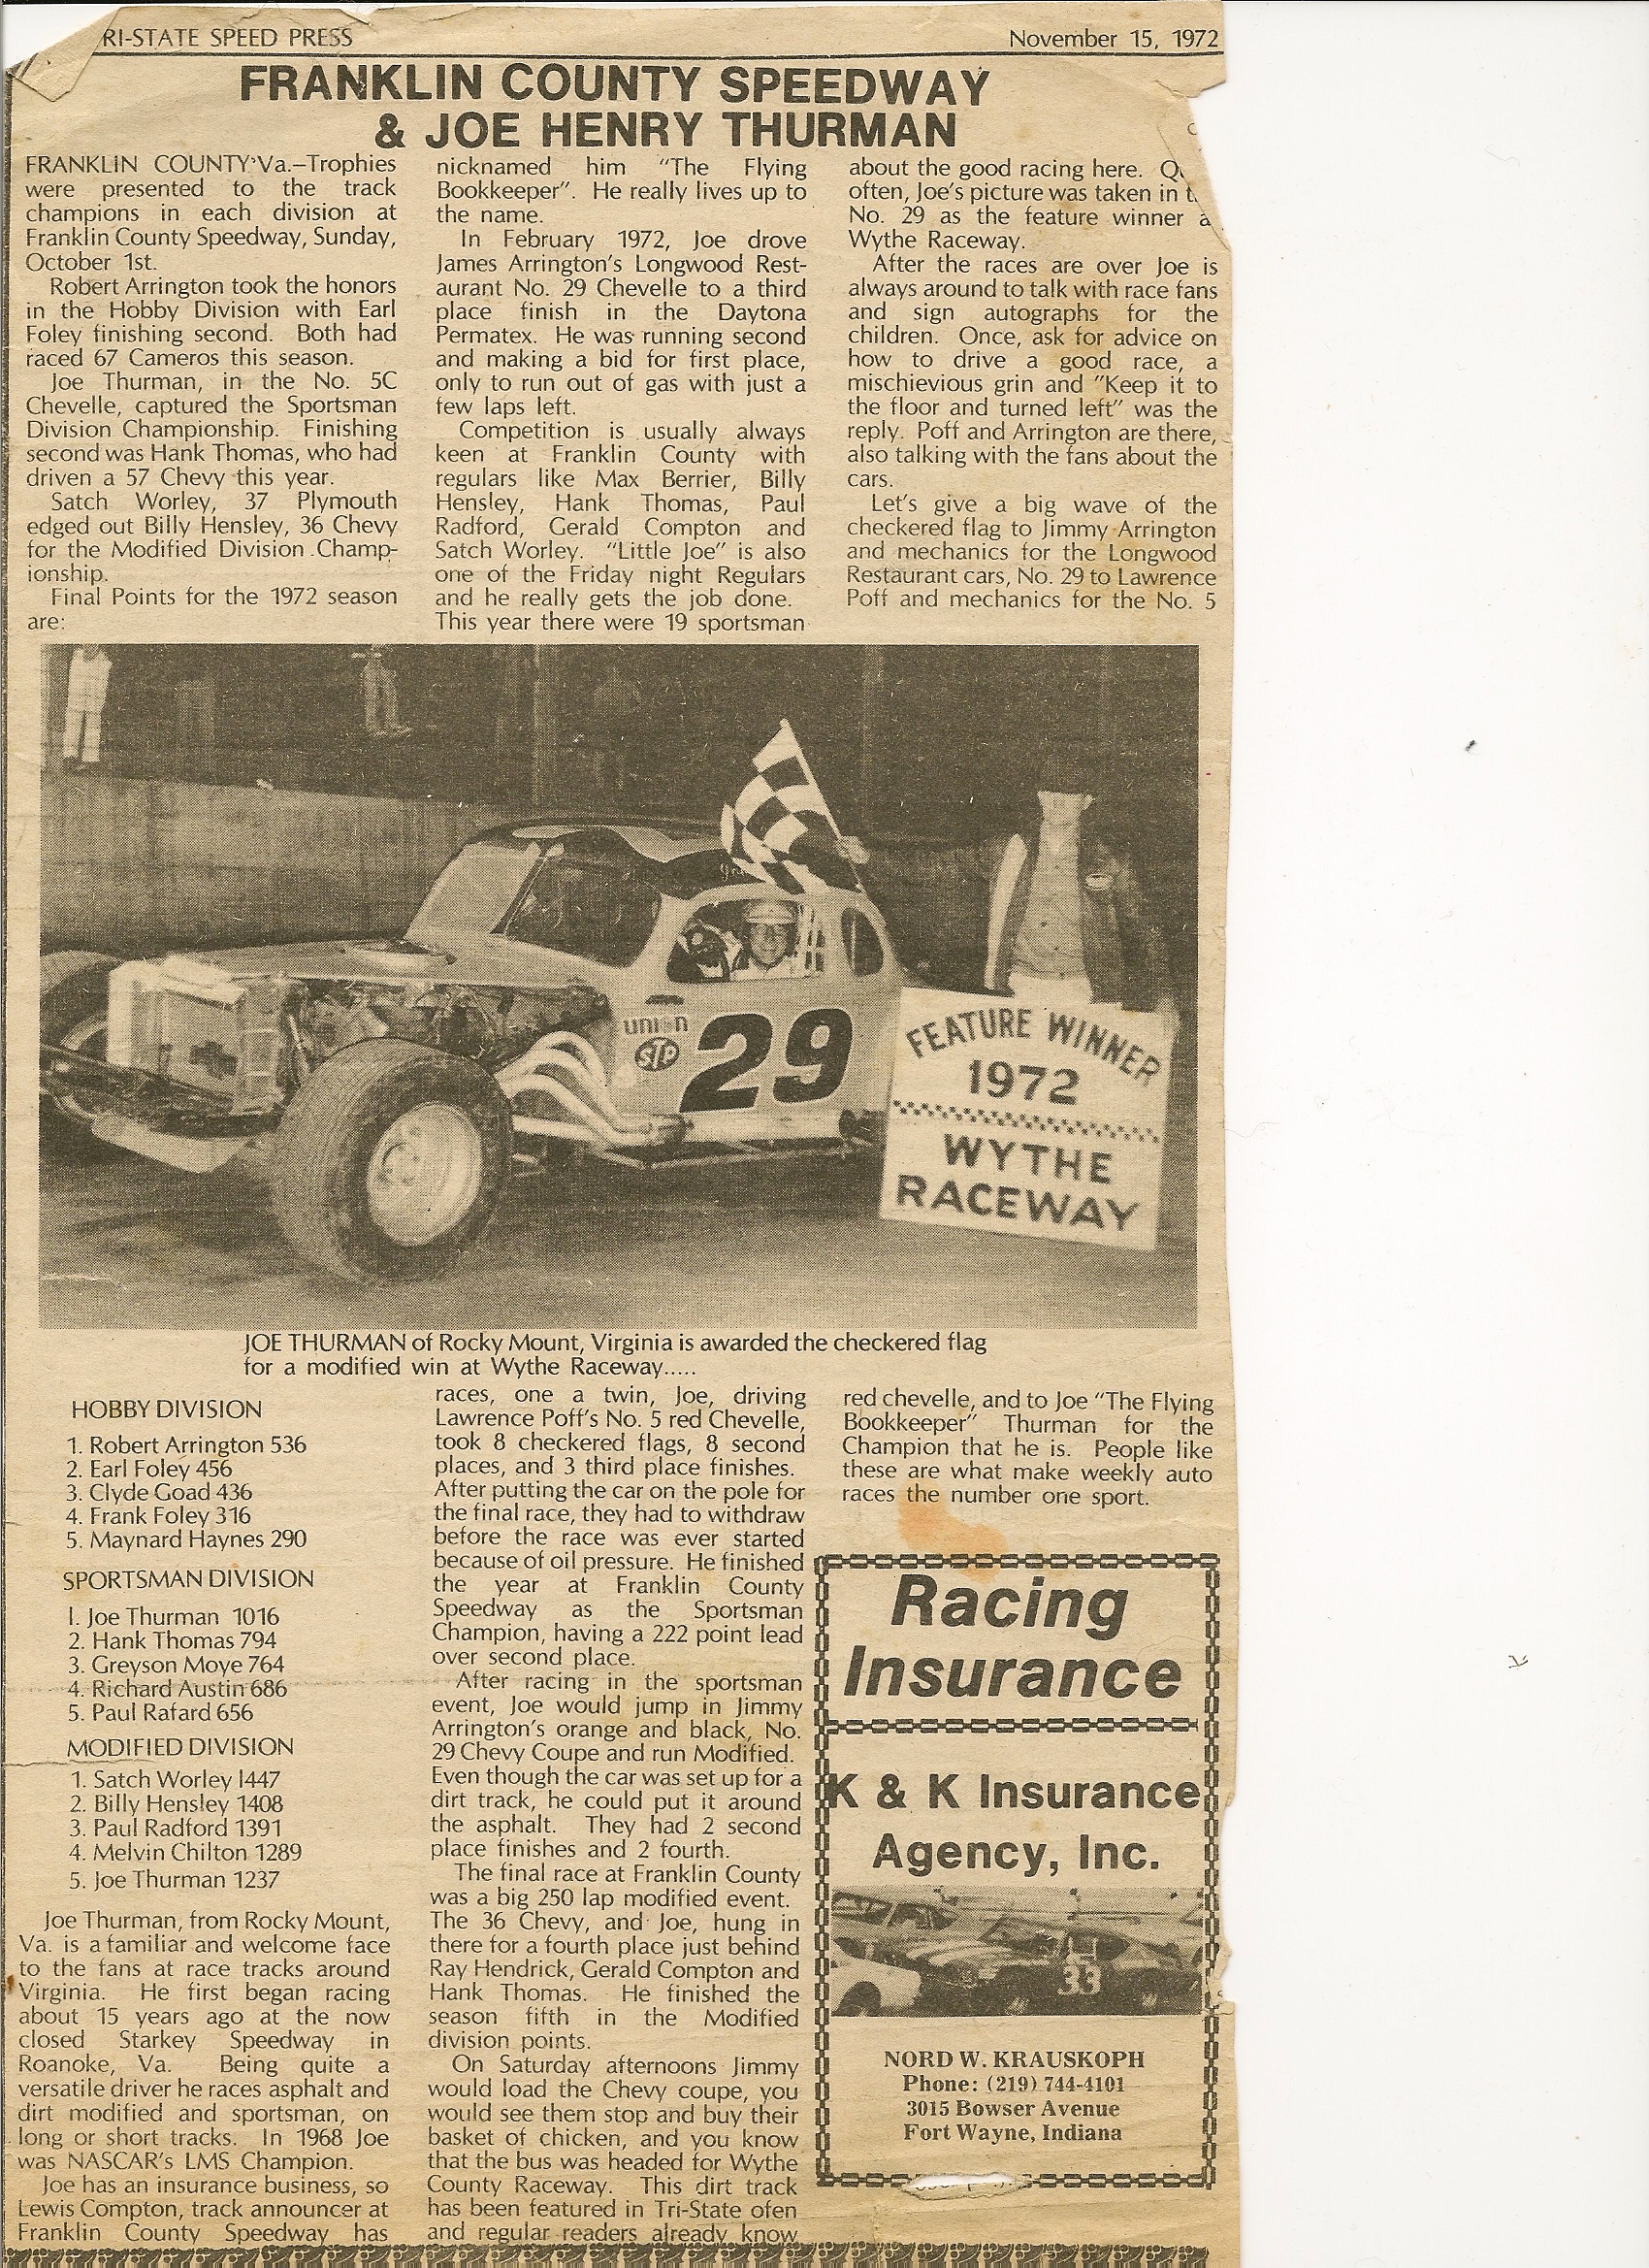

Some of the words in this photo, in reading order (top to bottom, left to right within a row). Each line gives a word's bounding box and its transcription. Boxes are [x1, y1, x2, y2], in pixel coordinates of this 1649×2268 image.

[102, 27, 200, 48] RI-STATE
[210, 27, 278, 48] SPEED
[289, 26, 353, 48] PRESS
[1010, 27, 1118, 49] November
[1129, 29, 1159, 50] 15,
[1172, 28, 1219, 49] 1972
[241, 63, 482, 102] FRANKLIN
[501, 62, 701, 102] COUNTY
[719, 65, 990, 107] SPEEDWAY
[374, 113, 406, 149] &
[425, 111, 520, 149] JOE
[541, 111, 703, 147] HENRY
[721, 111, 956, 148] THURMAN
[436, 155, 552, 176] nicknamed
[586, 155, 626, 176] him
[744, 156, 807, 181] Flying
[24, 183, 76, 198] were
[102, 177, 204, 203] presented
[232, 179, 255, 197] to
[281, 177, 316, 197] the
[343, 176, 397, 197] track
[848, 228, 918, 252] Wythe
[928, 230, 1025, 254] Raceway.
[848, 300, 887, 321] and
[913, 302, 954, 325] sign
[984, 302, 1099, 326] autographs
[1126, 303, 1157, 323] for
[1184, 303, 1219, 323] the
[459, 419, 589, 443] Competition
[609, 420, 625, 439] is
[644, 419, 718, 444] usually
[736, 420, 806, 445] always
[51, 490, 108, 511] Satch
[135, 490, 216, 514] Worley,
[244, 491, 269, 510] 37
[298, 489, 398, 514] Plymouth
[847, 565, 958, 585] Restaurant
[963, 570, 1011, 588] cars,
[1018, 567, 1053, 585] No.
[1060, 567, 1084, 586] 29
[1089, 568, 1112, 586] to
[1118, 567, 1217, 587] Lawrence
[51, 586, 101, 606] Final
[112, 587, 176, 605] Points
[185, 585, 215, 605] for
[224, 585, 259, 605] the
[271, 586, 317, 605] 1972
[328, 591, 398, 605] season
[636, 1038, 679, 1071] STP
[906, 1008, 1032, 1058] FEATURE
[1048, 1012, 1160, 1085] WINNER
[679, 1008, 853, 1113] 29
[969, 1059, 1080, 1105] 1972
[944, 1133, 1113, 1184] WYTHE
[896, 1175, 1140, 1231] RACEWAY
[243, 1333, 282, 1355] JOE
[287, 1333, 406, 1352] THURMAN
[411, 1332, 434, 1352] of
[439, 1332, 503, 1356] Rocky
[508, 1333, 585, 1356] Mount,
[590, 1333, 674, 1356] Virginia
[679, 1333, 695, 1352] is
[699, 1331, 789, 1352] awarded
[793, 1331, 828, 1352] the
[833, 1331, 941, 1352] checkered
[947, 1331, 987, 1355] flag
[242, 1355, 274, 1376] for
[283, 1361, 297, 1376] a
[307, 1355, 401, 1377] modified
[410, 1356, 449, 1376] win
[460, 1358, 481, 1376] at
[490, 1355, 561, 1379] Wythe
[72, 1399, 151, 1419] HOBBY
[156, 1399, 262, 1419] DIVISION
[1003, 1412, 1096, 1434] Thurman
[1123, 1414, 1154, 1435] for
[1180, 1415, 1214, 1436] the
[67, 1436, 83, 1455] 1.
[90, 1434, 160, 1455] Robert
[164, 1435, 264, 1458] Arrington
[271, 1435, 307, 1454] 536
[66, 1460, 82, 1478] 2.
[90, 1458, 127, 1478] Earl
[134, 1458, 191, 1482] Foley
[195, 1459, 233, 1478] 456
[842, 1488, 895, 1503] races
[906, 1482, 940, 1504] the
[951, 1484, 1032, 1505] number
[1042, 1491, 1082, 1506] one
[1091, 1489, 1149, 1509] sport.
[62, 1570, 203, 1591] SPORTSMAN
[209, 1569, 314, 1589] DIVISION
[433, 1597, 537, 1622] Speedway
[571, 1604, 593, 1618] as
[626, 1598, 661, 1619] the
[694, 1600, 803, 1623] Sportsman
[890, 1574, 1129, 1641] Racing
[68, 1632, 85, 1650] 2.
[92, 1630, 146, 1650] Hank
[152, 1629, 235, 1650] Thomas
[240, 1631, 277, 1650] 794
[844, 1645, 1182, 1699] Insurance
[67, 1737, 183, 1758] MODIFIED
[189, 1736, 294, 1757] DIVISION
[827, 1773, 858, 1809] K
[876, 1773, 907, 1809] &
[929, 1773, 959, 1809] K
[980, 1773, 1201, 1810] Insurance
[70, 1795, 86, 1813] 2.
[94, 1793, 141, 1817] Billy
[146, 1793, 230, 1817] Hensley
[237, 1795, 284, 1813] 1408
[68, 1843, 86, 1862] 4.
[93, 1841, 165, 1862] Melvin
[171, 1841, 247, 1862] Chilton
[254, 1842, 303, 1862] 1289
[872, 1833, 1059, 1877] Agency,
[1080, 1833, 1160, 1870] Inc.
[1057, 1965, 1101, 1995] 33
[429, 2011, 498, 2025] season
[525, 2005, 569, 2025] fifth
[598, 2007, 616, 2026] in
[643, 2006, 677, 2026] the
[703, 2007, 799, 2027] Modified
[18, 2028, 85, 2049] closed
[119, 2028, 197, 2054] Starkey
[230, 2028, 335, 2054] Speedway
[371, 2030, 389, 2050] in
[884, 2050, 954, 2068] NORD
[958, 2050, 987, 2068] W.
[992, 2051, 1146, 2069] KRAUSKOPH
[902, 2074, 978, 2092] Phone:
[986, 2075, 1038, 2093] (219)
[1044, 2076, 1125, 2093] 744-4101
[906, 2100, 950, 2117] 3015
[955, 2099, 1036, 2118] Bowser
[1040, 2099, 1120, 2118] Avenue
[903, 2123, 952, 2141] Fort
[955, 2122, 1036, 2146] Wayne,
[1042, 2122, 1122, 2141] Indiana
[16, 2156, 56, 2170] was
[185, 2151, 230, 2171] LMS
[241, 2150, 354, 2175] Champion.
[427, 2174, 502, 2198] County
[514, 2175, 613, 2198] Raceway.
[639, 2174, 683, 2195] This
[695, 2175, 733, 2195] dirt
[745, 2176, 797, 2196] track
